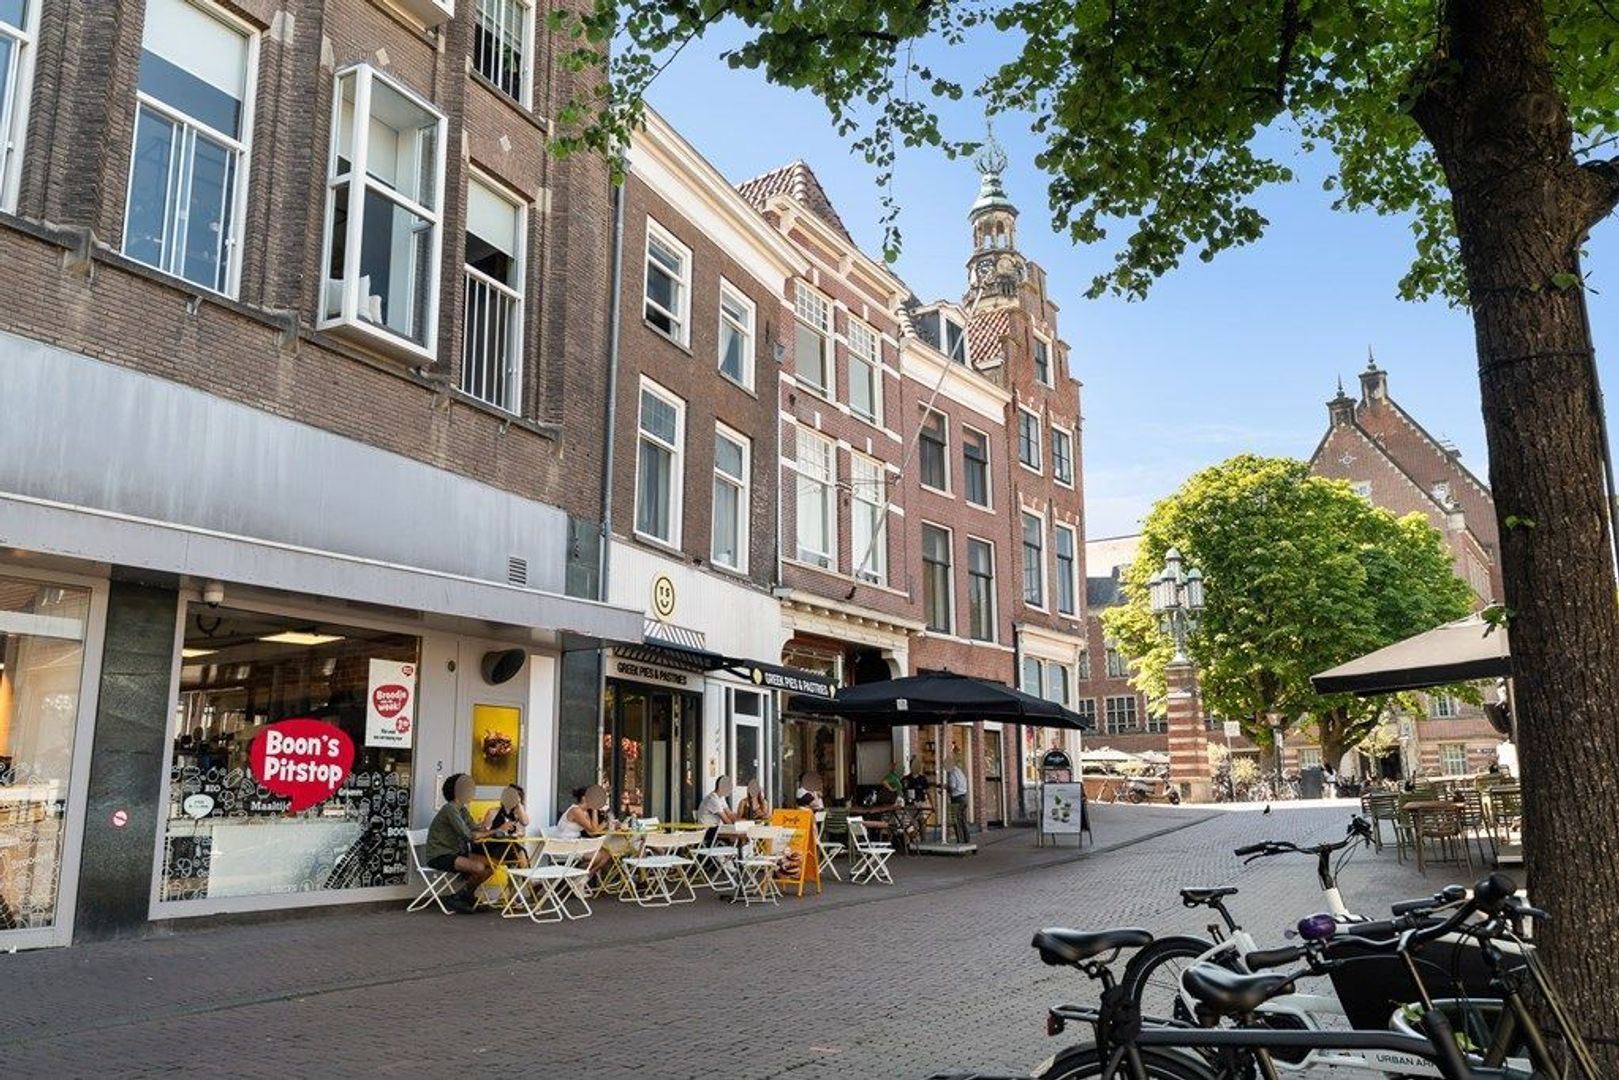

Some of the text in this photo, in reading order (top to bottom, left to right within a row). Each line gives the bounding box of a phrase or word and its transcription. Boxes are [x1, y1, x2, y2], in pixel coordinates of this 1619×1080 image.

[616, 661, 638, 677] GREEK
[639, 666, 654, 679] PIES
[659, 670, 687, 686] PASTRIES
[764, 672, 783, 686] GREEK
[784, 676, 798, 690] PIES
[803, 680, 829, 696] PASTRIES
[266, 730, 340, 758] Boon's
[264, 756, 343, 790] Pitstop
[1376, 1054, 1414, 1066] URBAN
